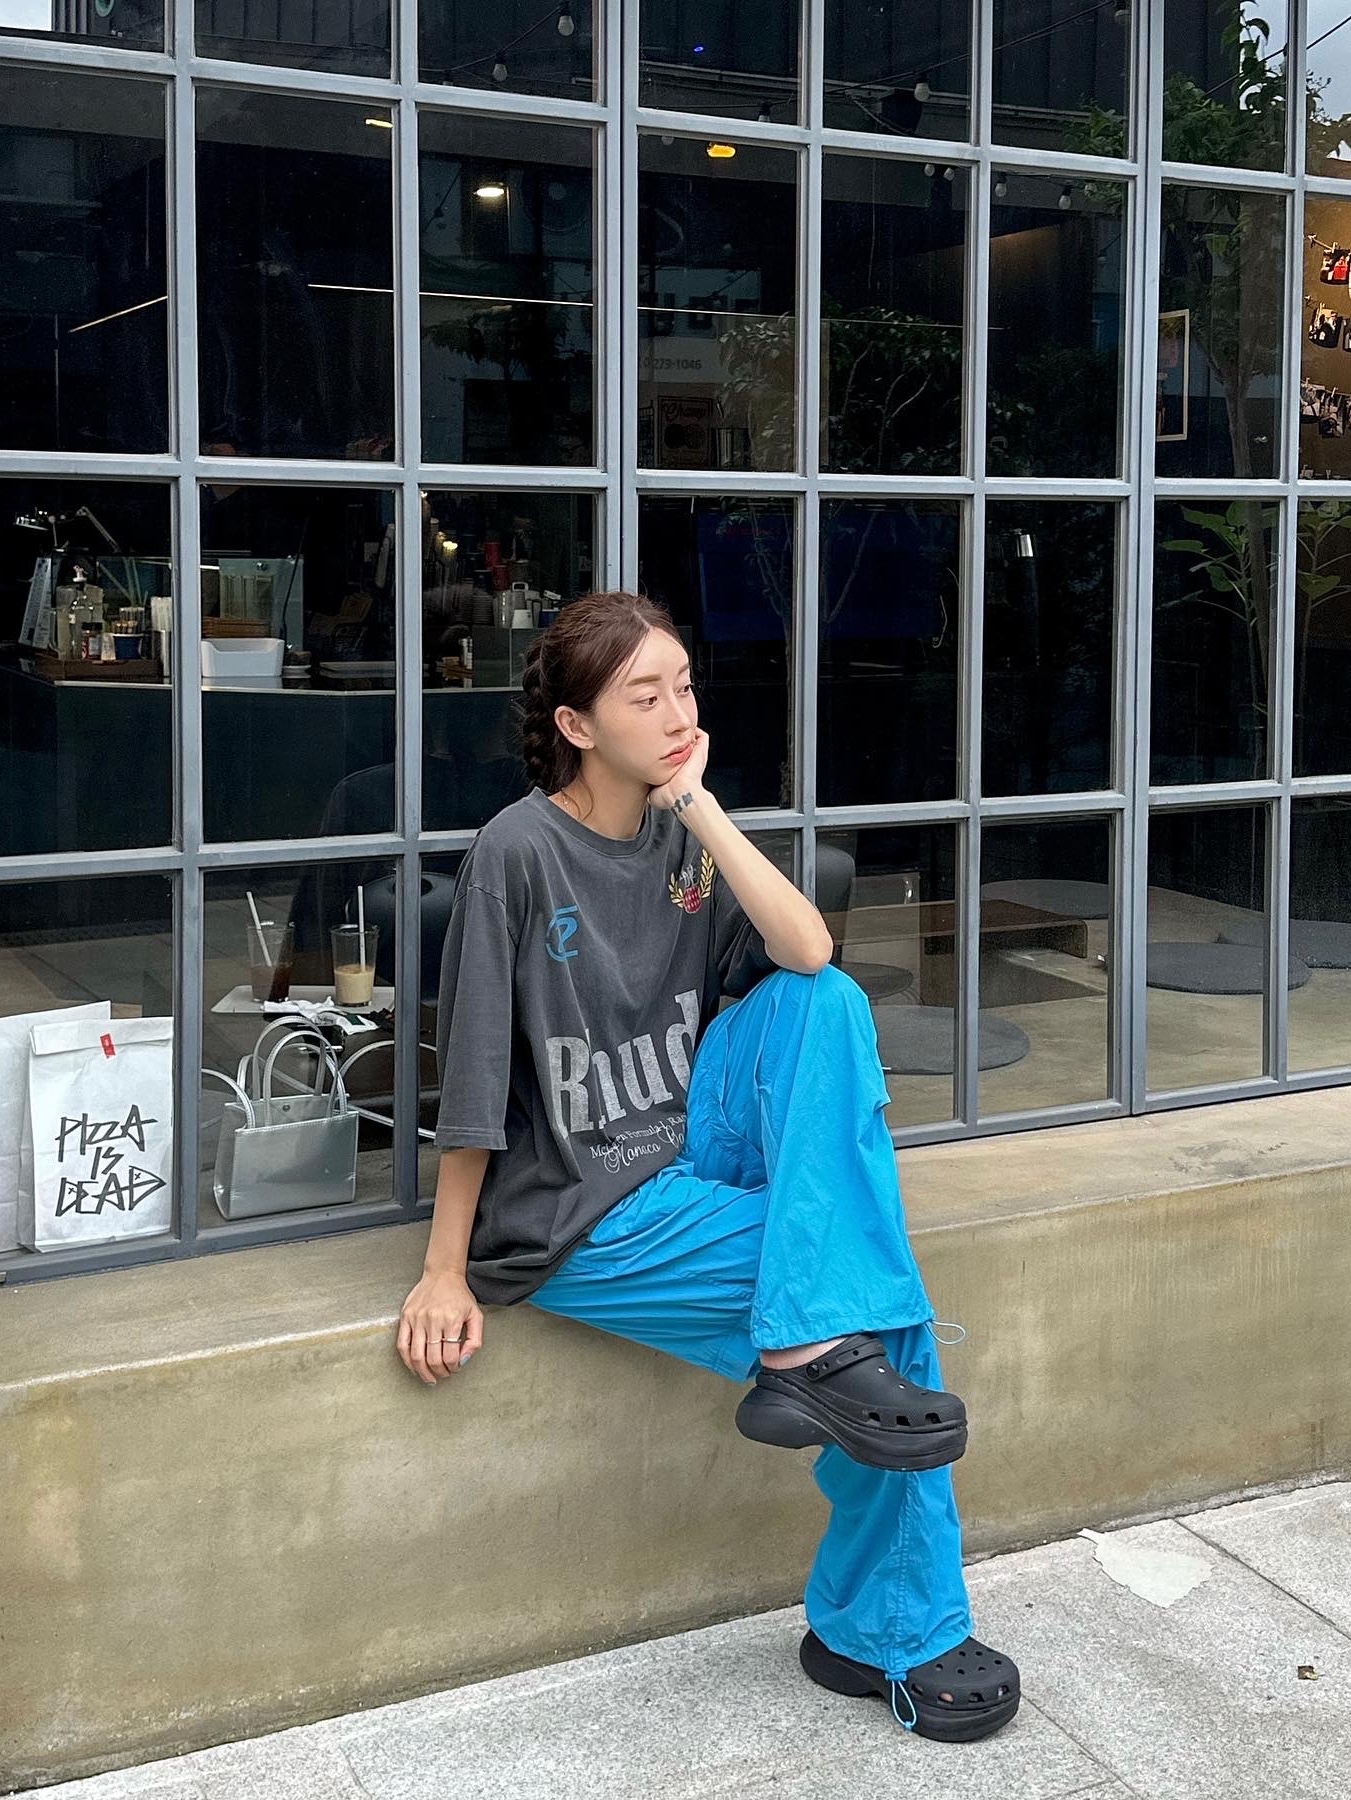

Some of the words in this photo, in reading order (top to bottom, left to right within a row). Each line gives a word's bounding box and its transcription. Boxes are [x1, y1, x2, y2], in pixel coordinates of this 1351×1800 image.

[55, 1104, 158, 1163] PIZZA
[90, 1146, 124, 1180] IS
[55, 1165, 167, 1217] DEAD
